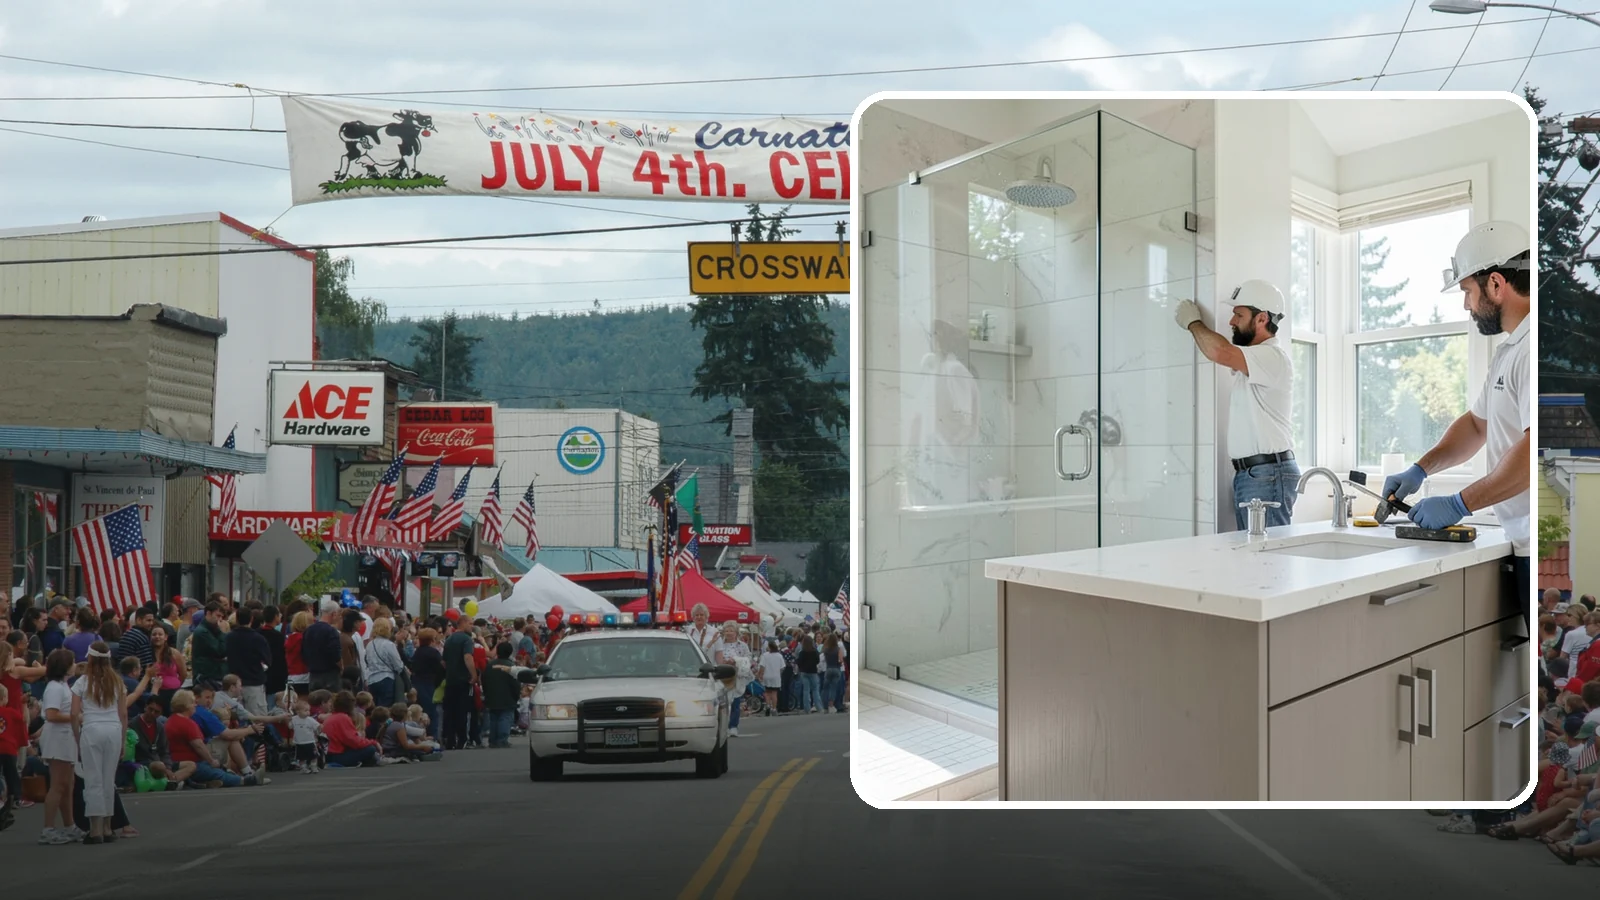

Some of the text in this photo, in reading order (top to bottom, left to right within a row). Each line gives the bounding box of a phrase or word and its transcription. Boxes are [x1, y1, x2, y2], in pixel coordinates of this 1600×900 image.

[481, 140, 605, 193] JULY
[632, 150, 747, 198] 4th.
[696, 254, 850, 280] CROSSWA
[282, 380, 374, 420] ACE
[405, 408, 453, 422] CEDAR
[283, 421, 371, 437] Hardware
[353, 466, 386, 480] Simpl
[95, 485, 124, 495] Vincent
[126, 485, 136, 495] de
[138, 485, 155, 495] Paul
[688, 527, 741, 535] CRNATION
[699, 535, 730, 543] GLASS
